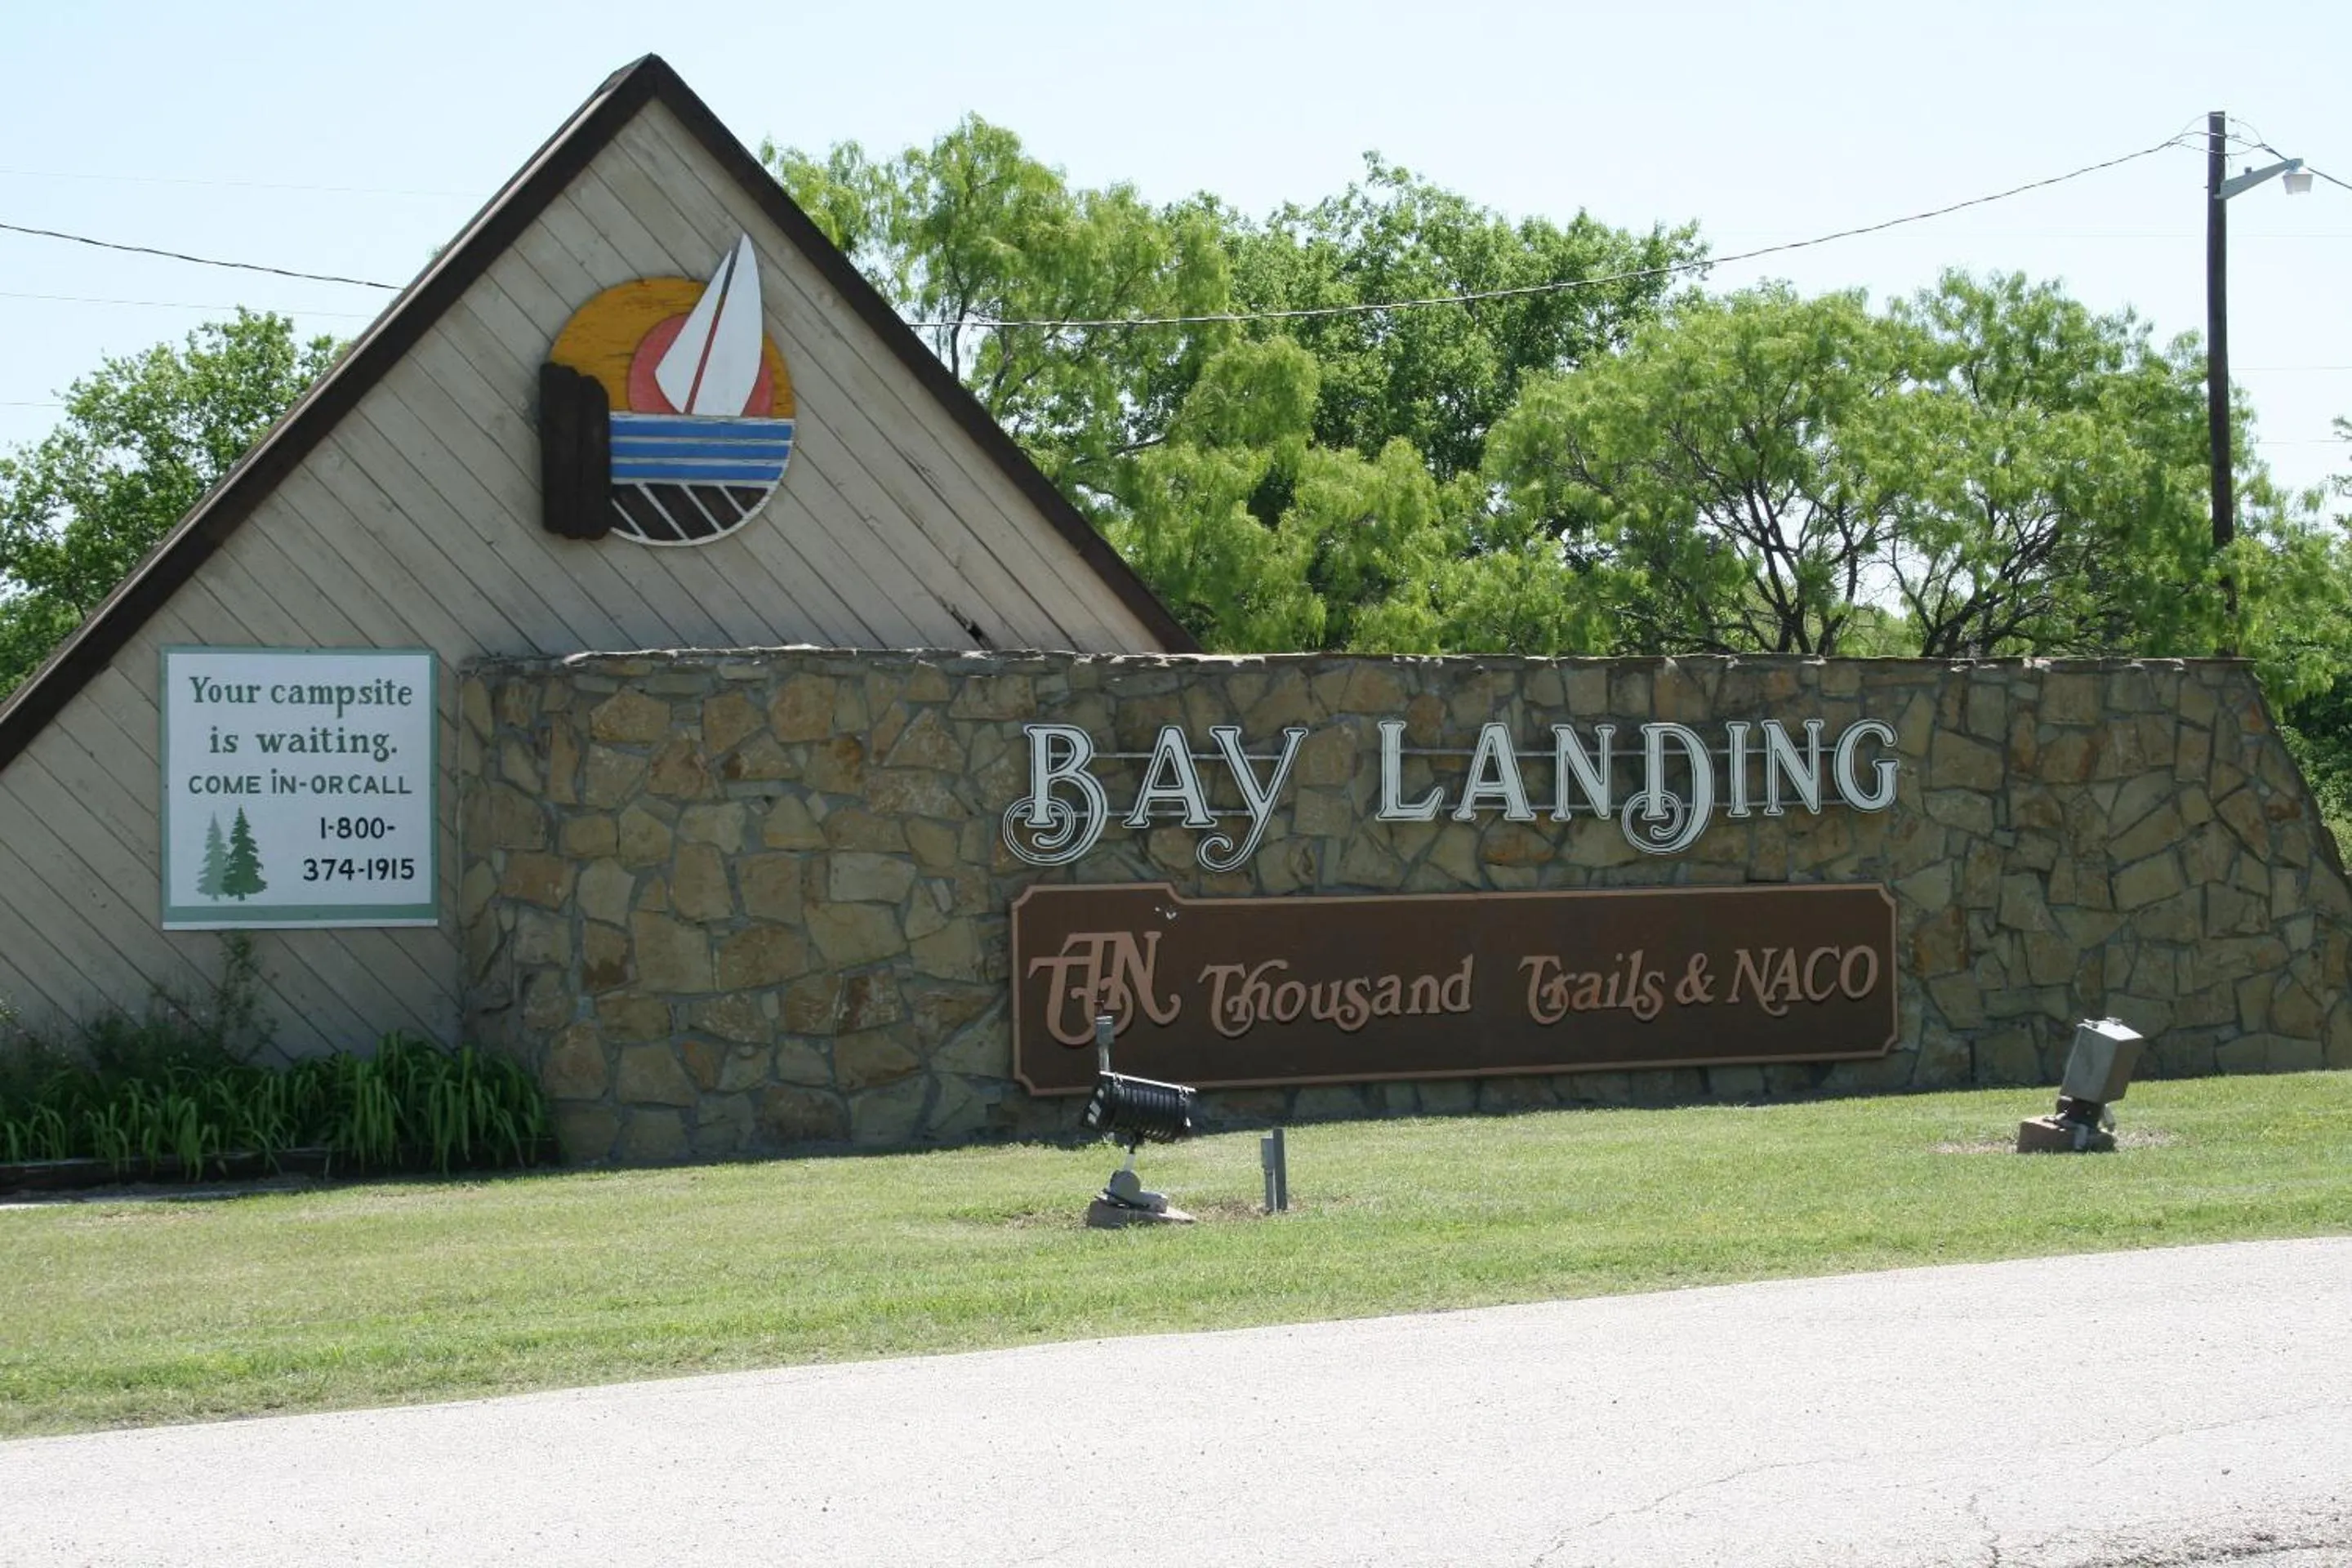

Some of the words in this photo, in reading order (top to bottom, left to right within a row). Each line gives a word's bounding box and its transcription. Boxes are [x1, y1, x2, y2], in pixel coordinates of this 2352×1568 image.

[189, 677, 261, 703] Your
[270, 679, 413, 719] campsite
[209, 726, 238, 753] is
[256, 727, 398, 763] waiting.
[189, 775, 261, 795] COME
[1003, 724, 1308, 873] BAY
[1375, 719, 1900, 854] LANDING
[320, 817, 396, 839] 1-800-
[302, 858, 415, 881] 374-1915
[1198, 954, 1473, 1038] Thousand
[1517, 950, 1665, 1025] Trails
[1674, 952, 1715, 1005] &
[1726, 945, 1878, 1018] NACO
